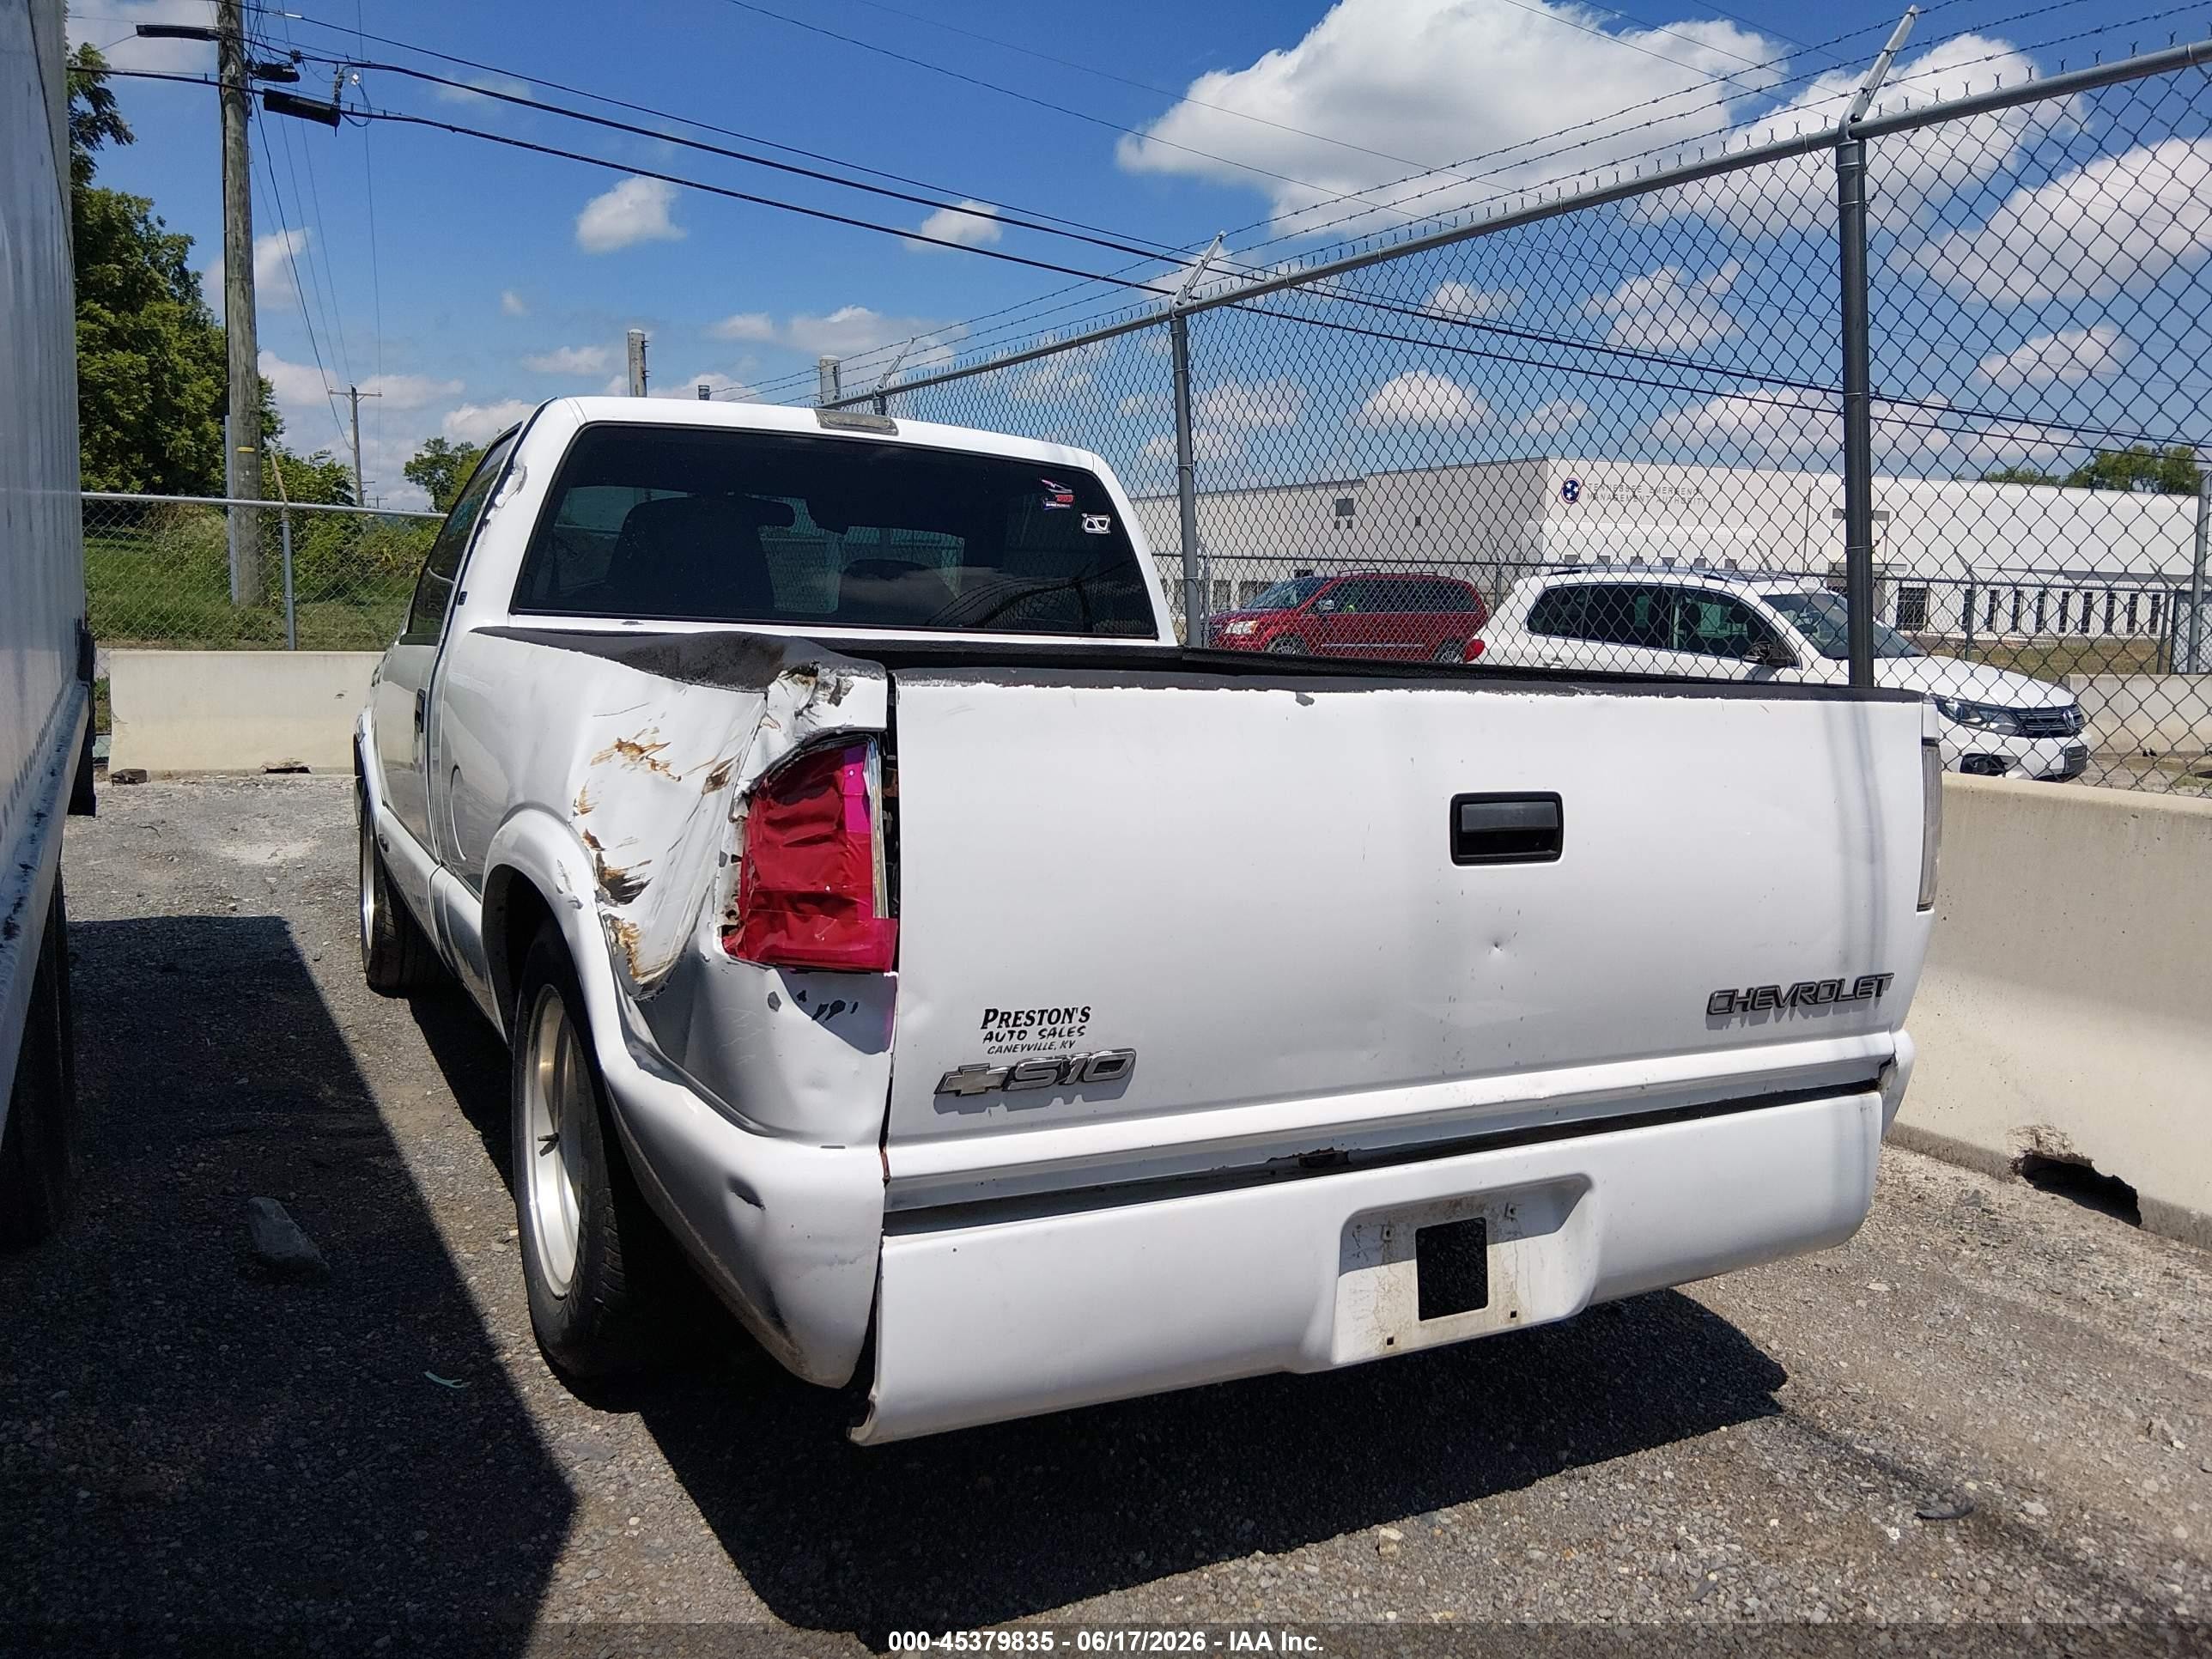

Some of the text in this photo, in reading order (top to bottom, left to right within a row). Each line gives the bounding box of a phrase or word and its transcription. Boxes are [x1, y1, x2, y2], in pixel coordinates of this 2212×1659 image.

[1588, 483, 1705, 495] TENNESSEE EMERGENCY
[1706, 972, 1895, 1015] CHEVROLET
[980, 1006, 1091, 1030] PRESTON'S
[982, 1025, 1087, 1044] AUTO SALES
[987, 1040, 1077, 1055] CANEYVILLE, KY
[1002, 1048, 1137, 1091] S10
